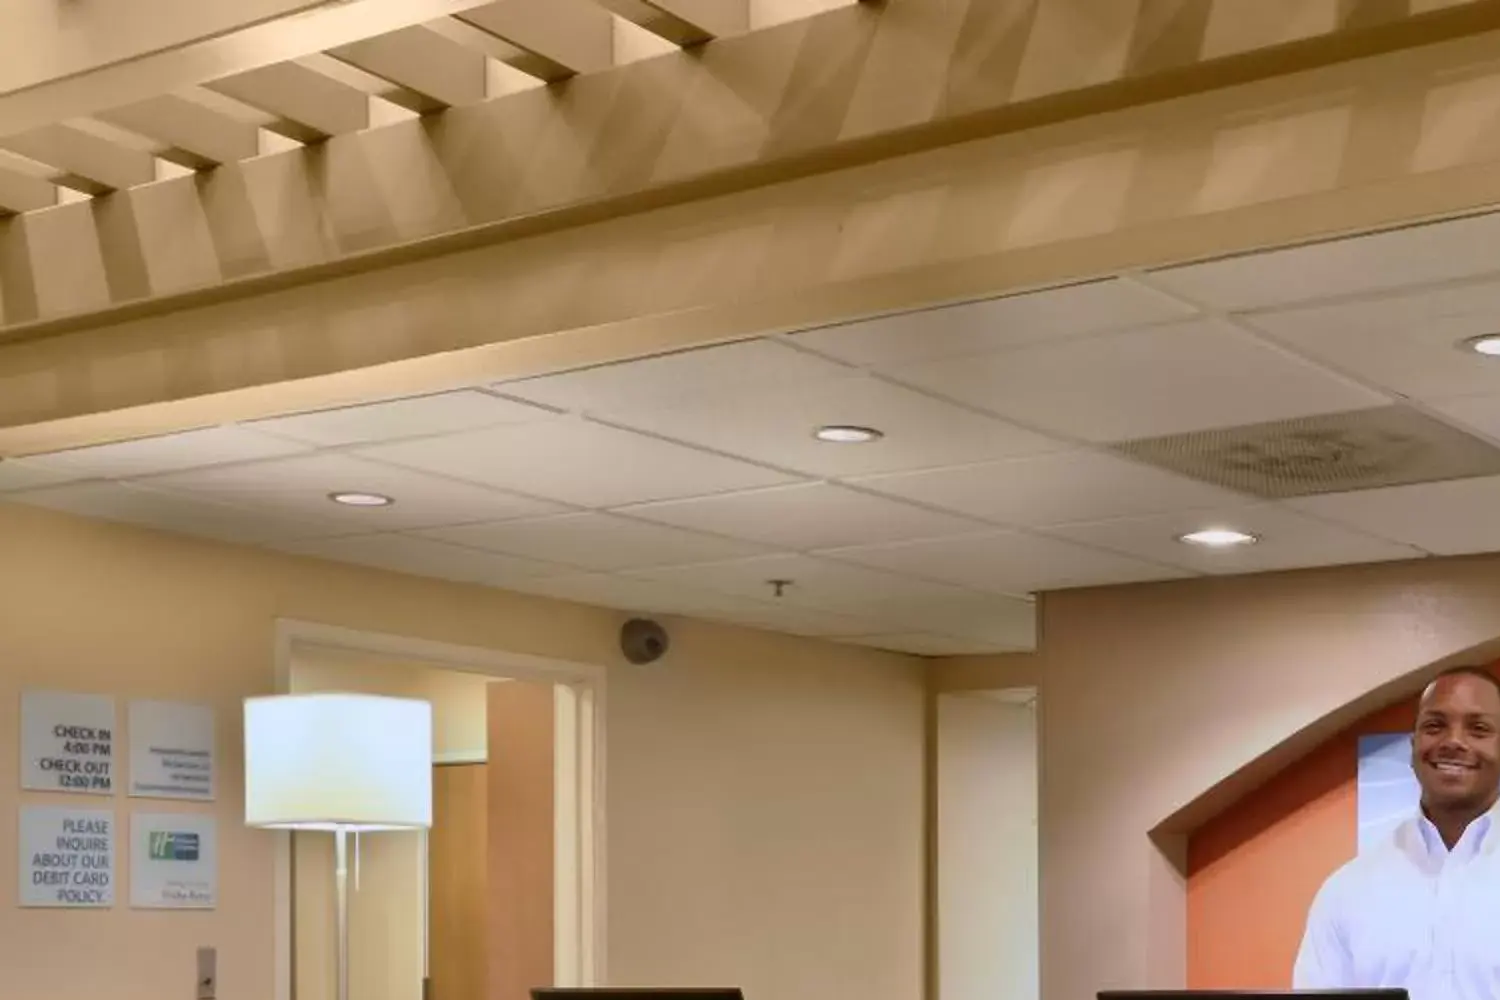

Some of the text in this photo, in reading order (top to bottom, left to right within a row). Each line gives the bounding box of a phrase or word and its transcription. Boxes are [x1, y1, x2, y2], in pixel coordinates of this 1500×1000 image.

[53, 725, 110, 741] CHECK IN
[64, 741, 110, 755] 4:00 PM
[40, 758, 109, 774] CHECK OUT
[59, 774, 110, 789] 12:00 PM
[63, 818, 109, 834] PLEASE
[56, 835, 108, 851] INQUIRE
[32, 852, 109, 869] ABOUT OUR
[33, 870, 109, 886] DEBIT CARD
